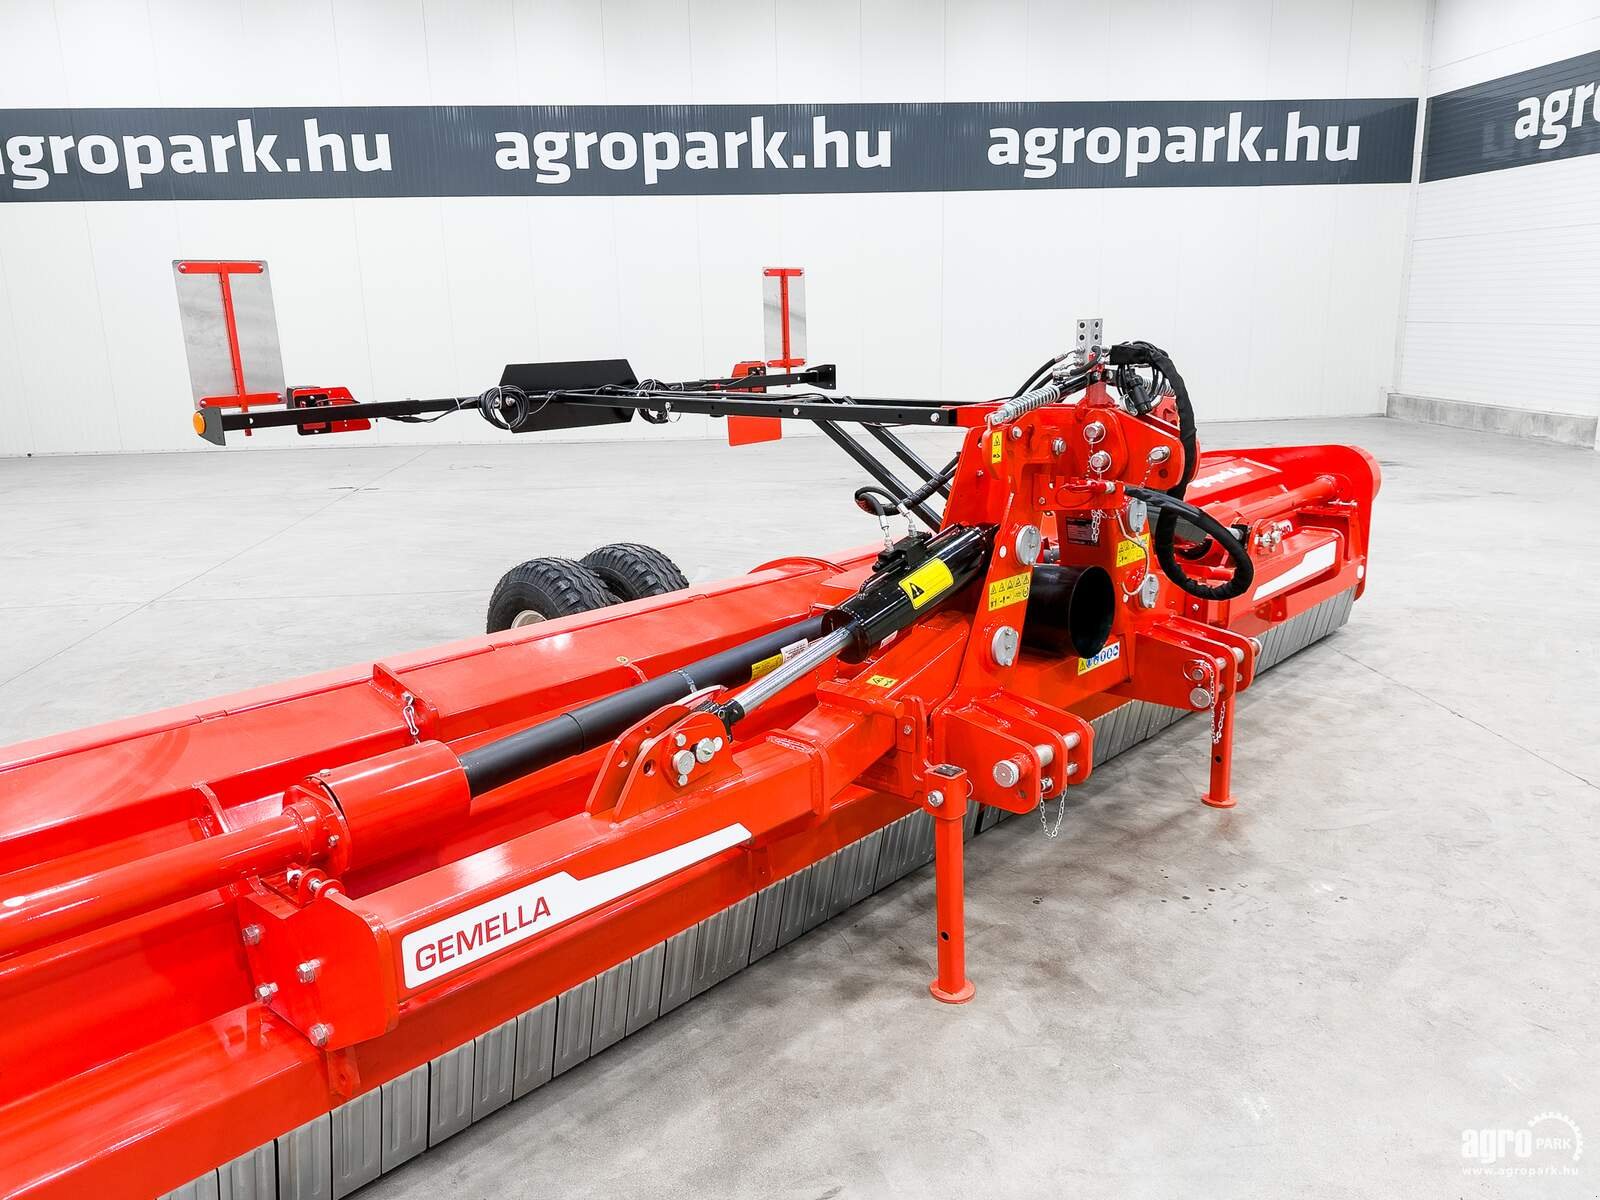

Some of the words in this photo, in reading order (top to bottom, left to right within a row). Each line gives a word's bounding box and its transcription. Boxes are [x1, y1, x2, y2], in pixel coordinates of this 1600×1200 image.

[0, 118, 392, 190] gropark.hu
[494, 115, 892, 186] agropark.hu
[988, 111, 1361, 179] agropark.hu
[414, 896, 552, 972] GEMELLA
